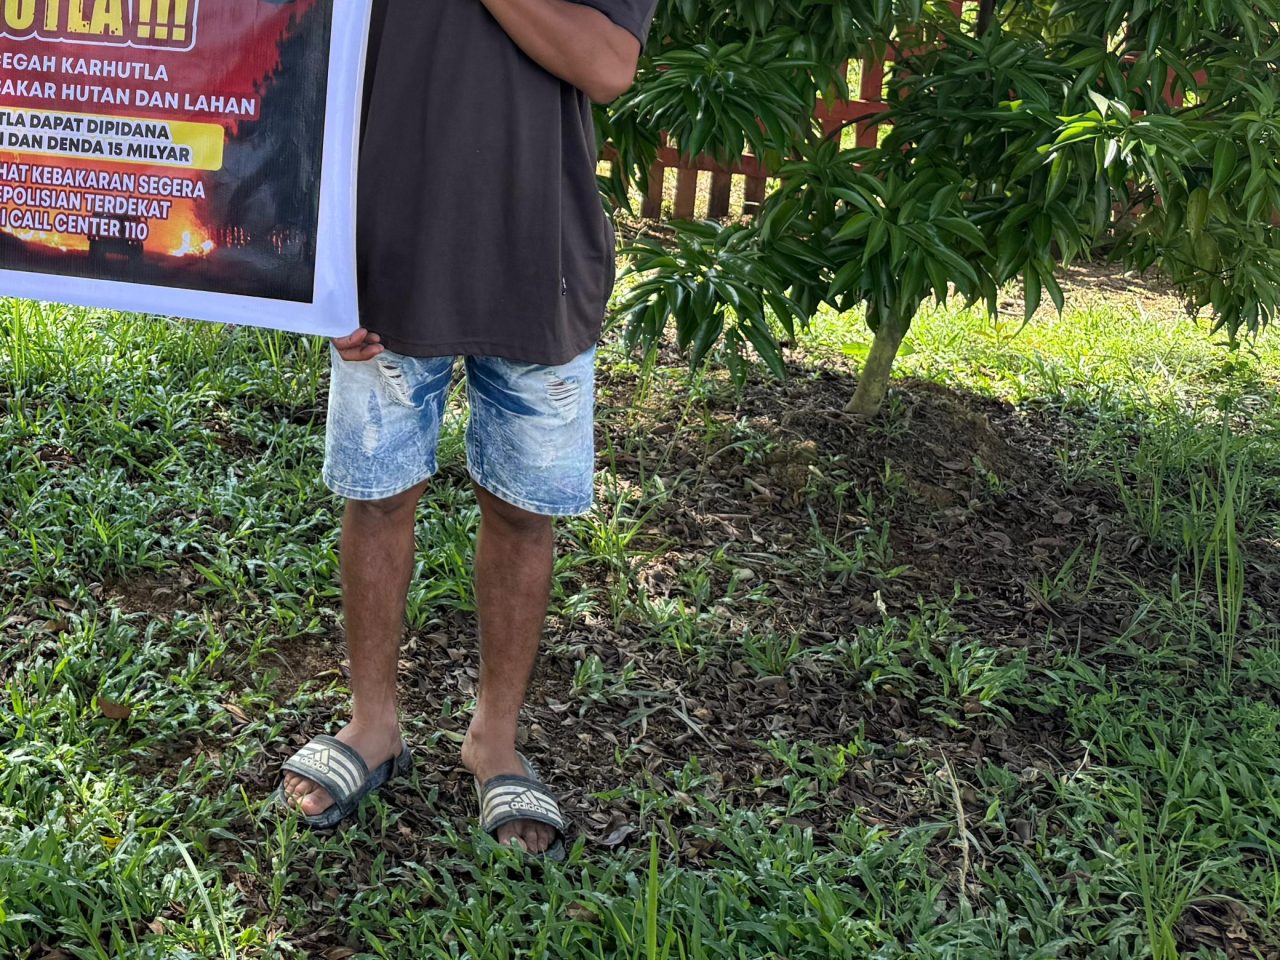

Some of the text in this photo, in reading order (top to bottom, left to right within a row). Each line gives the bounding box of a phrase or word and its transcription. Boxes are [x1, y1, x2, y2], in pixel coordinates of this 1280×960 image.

[61, 57, 169, 81] KARHUTLA
[61, 84, 130, 106] HUTAN
[135, 90, 179, 110] DAN
[184, 94, 256, 116] LAHAN
[29, 115, 84, 132] DAPAT
[86, 121, 170, 140] DIPIDANA
[7, 132, 43, 149] DAN
[47, 136, 104, 155] DENDA
[108, 141, 122, 156] 15
[126, 143, 190, 162] MILYAR
[31, 166, 135, 192] KEBAKARAN
[138, 175, 206, 199] SEGERA
[85, 194, 171, 219] TERDEKAT
[10, 210, 52, 230] CALL
[55, 214, 120, 237] CENTER
[124, 222, 148, 239] 110
[300, 755, 330, 773] adidas
[510, 801, 547, 814] adidas
